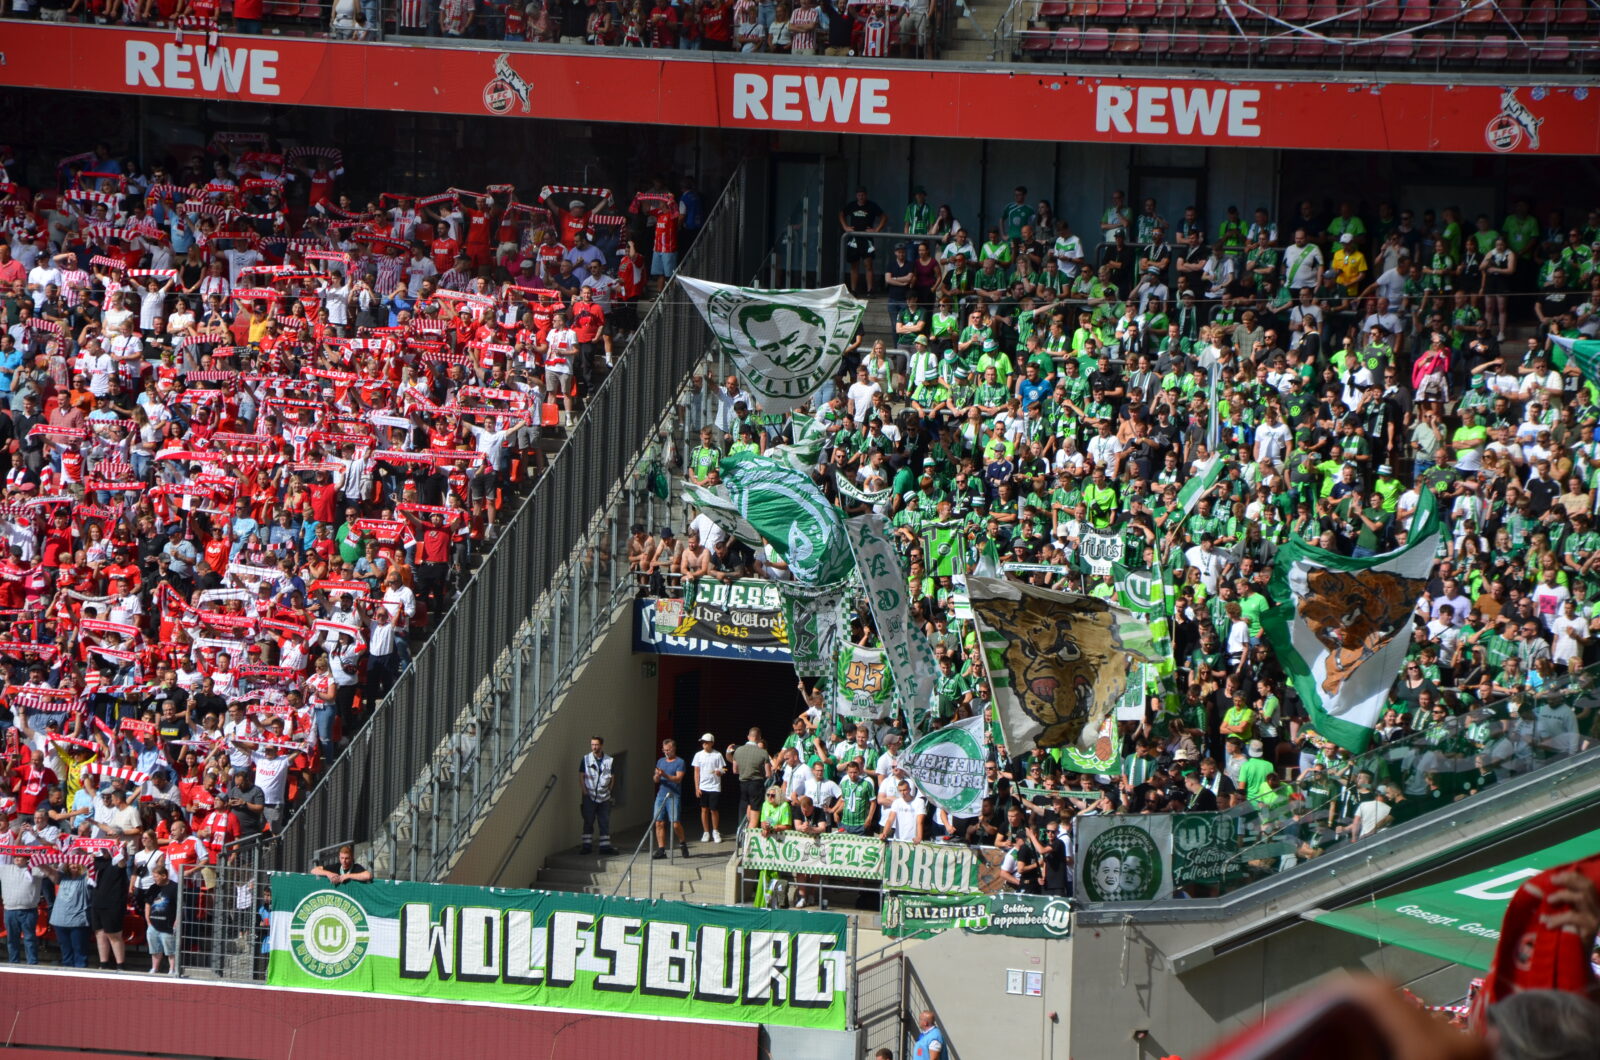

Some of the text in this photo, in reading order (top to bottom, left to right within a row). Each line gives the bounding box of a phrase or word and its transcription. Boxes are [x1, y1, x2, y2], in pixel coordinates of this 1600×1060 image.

[125, 40, 280, 96] REWE
[733, 73, 891, 125] REWE
[1095, 85, 1261, 137] REWE
[469, 386, 528, 402] KÖLN
[169, 485, 211, 496] FC Köln
[378, 521, 399, 530] KÖLN
[715, 624, 750, 639] 1945
[845, 662, 886, 692] 95
[258, 768, 276, 776] REWE
[829, 842, 882, 868] ELS
[886, 841, 978, 894] BROT
[297, 894, 364, 925] NORDKURVE
[904, 904, 986, 919] SALZGITTER
[1002, 903, 1034, 915] Sektion
[1395, 904, 1460, 927] Gesagt.
[988, 913, 1051, 930] Tappenbeck
[295, 942, 365, 976] WOLFSBURG
[400, 902, 838, 1009] WOLFSBURG
